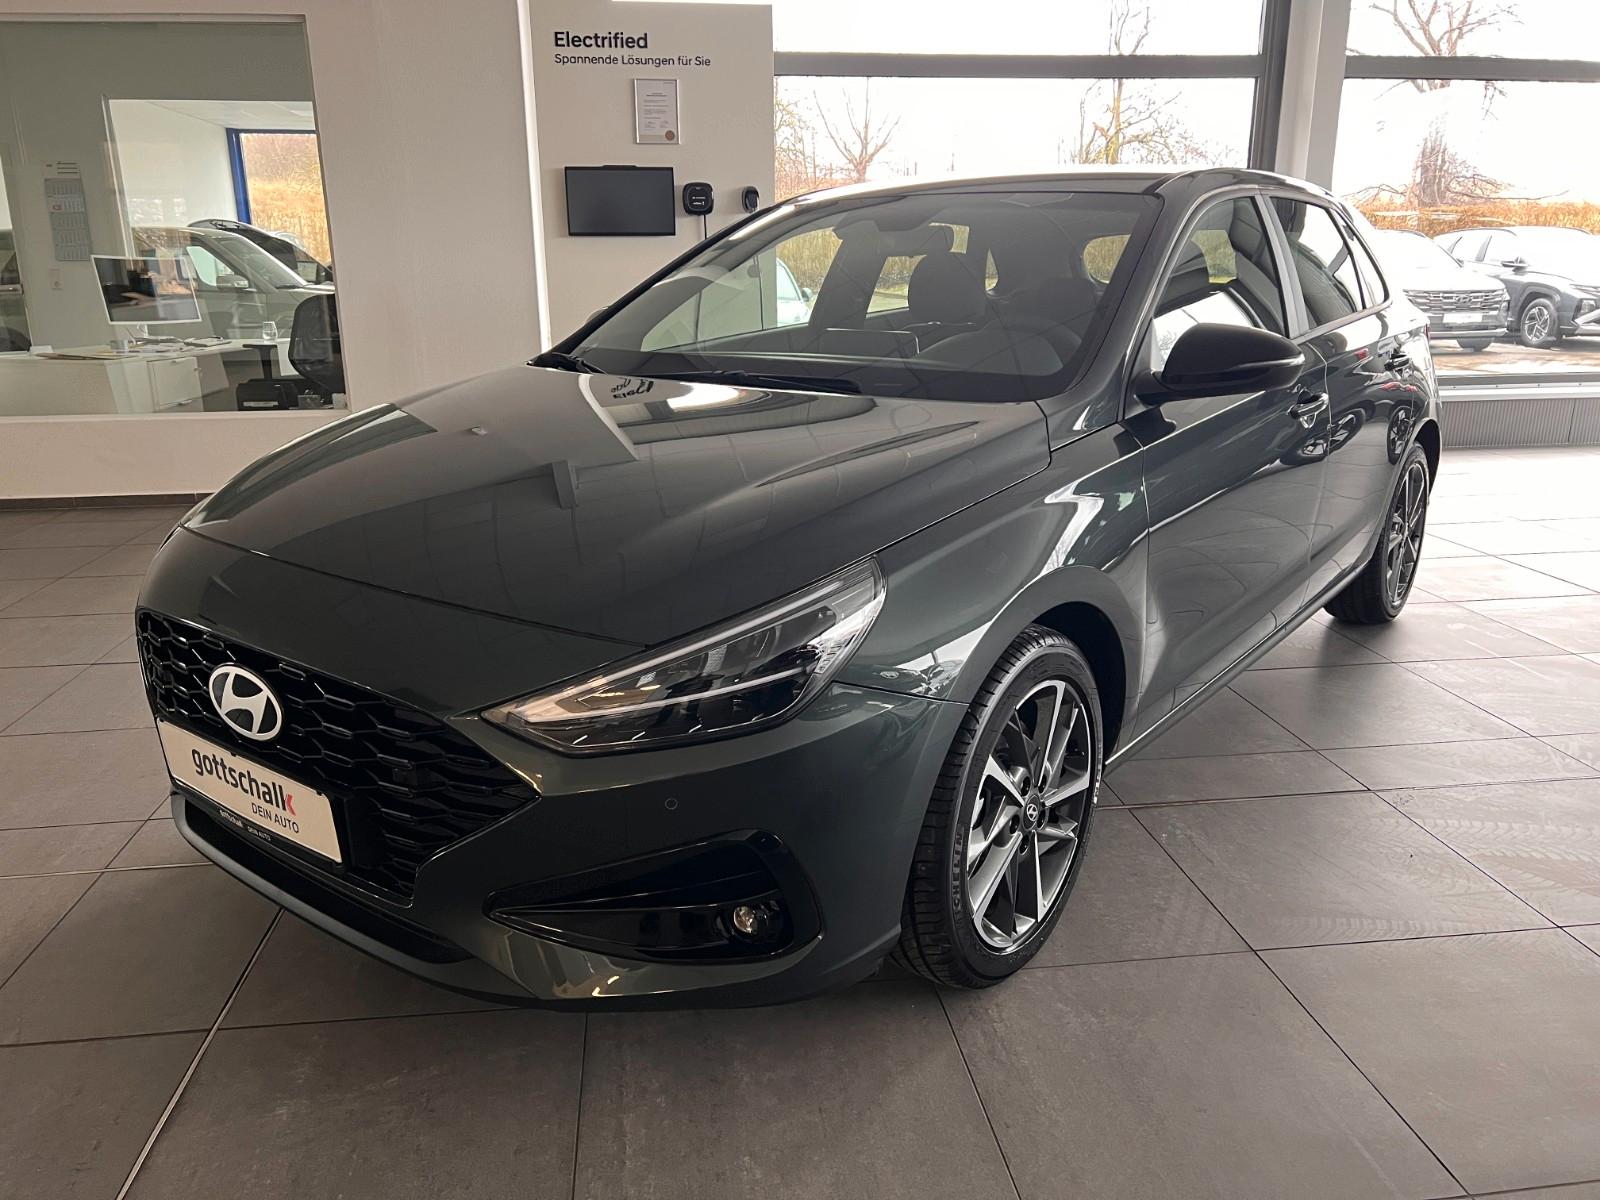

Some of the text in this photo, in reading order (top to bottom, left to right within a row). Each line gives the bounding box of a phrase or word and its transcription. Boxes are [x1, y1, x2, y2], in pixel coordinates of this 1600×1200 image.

[554, 31, 648, 49] Electrified
[554, 53, 711, 68] Spannende Lösungen für Sie
[192, 749, 296, 816] gottschalk
[251, 802, 300, 834] DEIN AUTO
